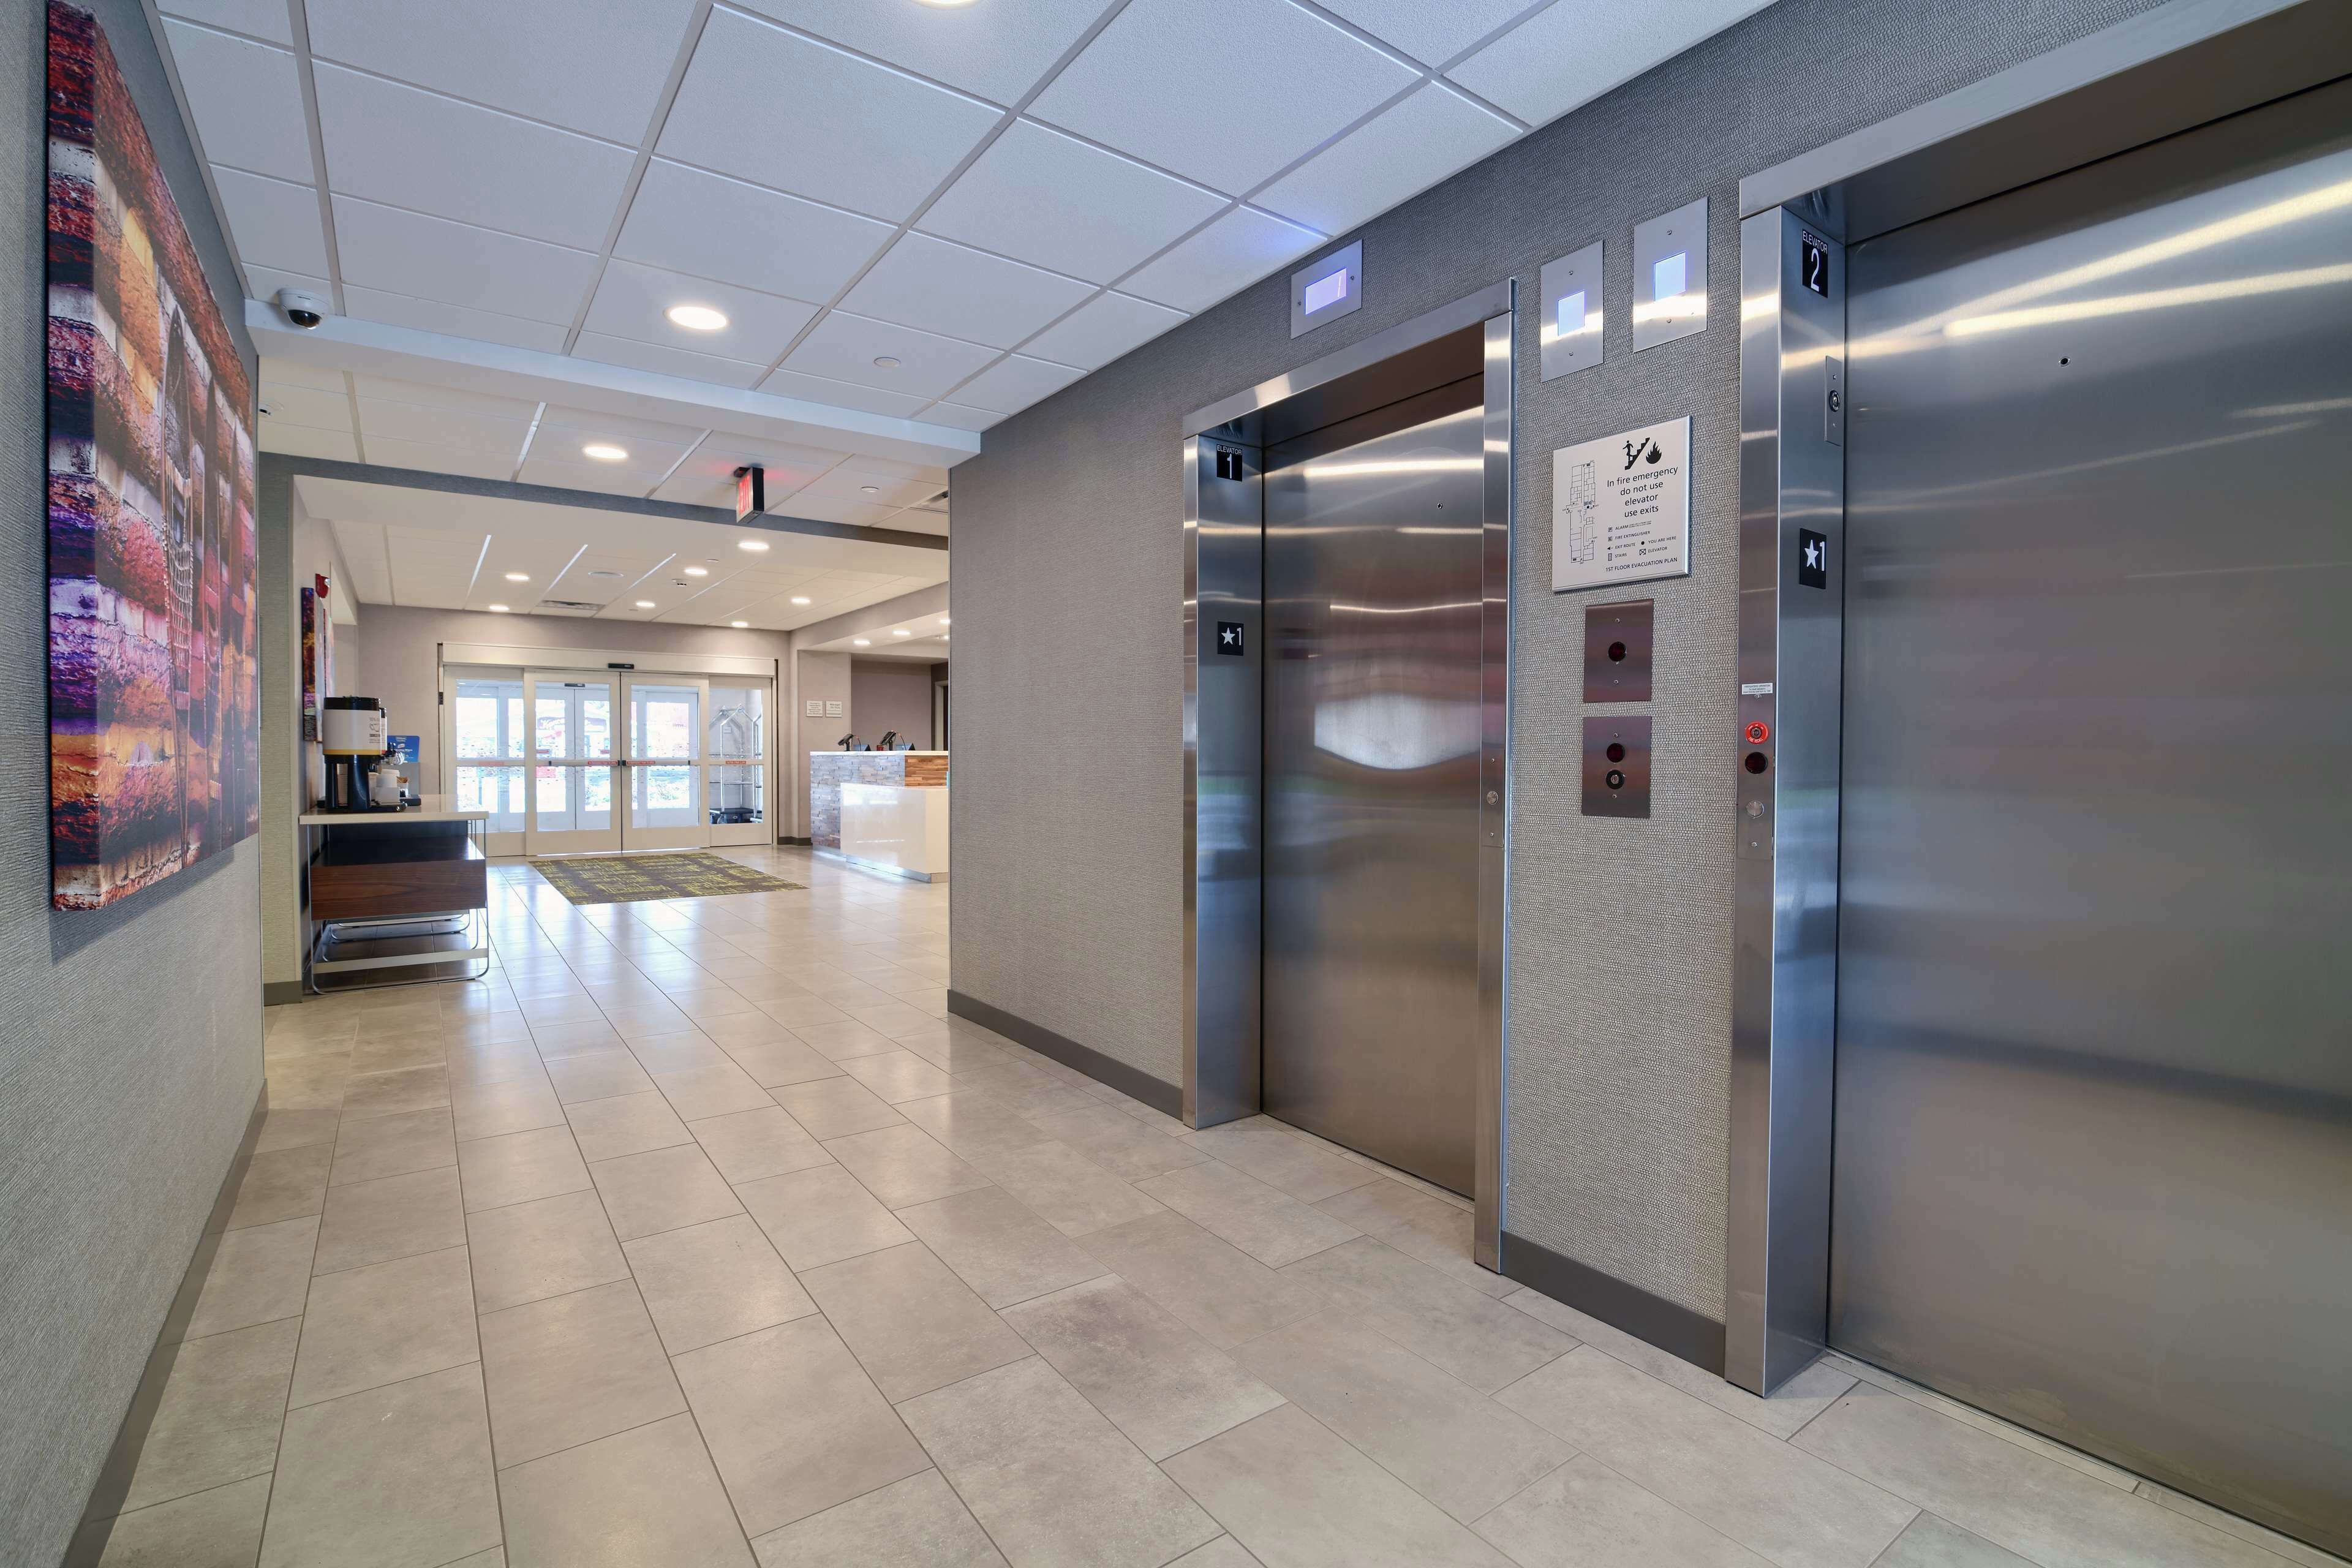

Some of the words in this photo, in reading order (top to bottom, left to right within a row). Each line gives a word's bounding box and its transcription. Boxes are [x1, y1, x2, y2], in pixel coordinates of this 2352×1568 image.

[1803, 230, 1828, 254] ELEVATOR
[1811, 247, 1819, 292] 2
[1217, 445, 1242, 456] ELEVATOR
[1227, 453, 1232, 479] 1
[1617, 477, 1630, 485] fire
[1632, 466, 1678, 482] emergency
[1633, 484, 1647, 493] not
[1649, 481, 1664, 490] use
[1625, 494, 1659, 506] elevator
[1640, 505, 1659, 514] exits
[1624, 530, 1651, 539] EXTINGUISHER
[1632, 559, 1663, 568] EVACUATION
[1819, 541, 1825, 571] 1
[1237, 627, 1242, 646] 1
